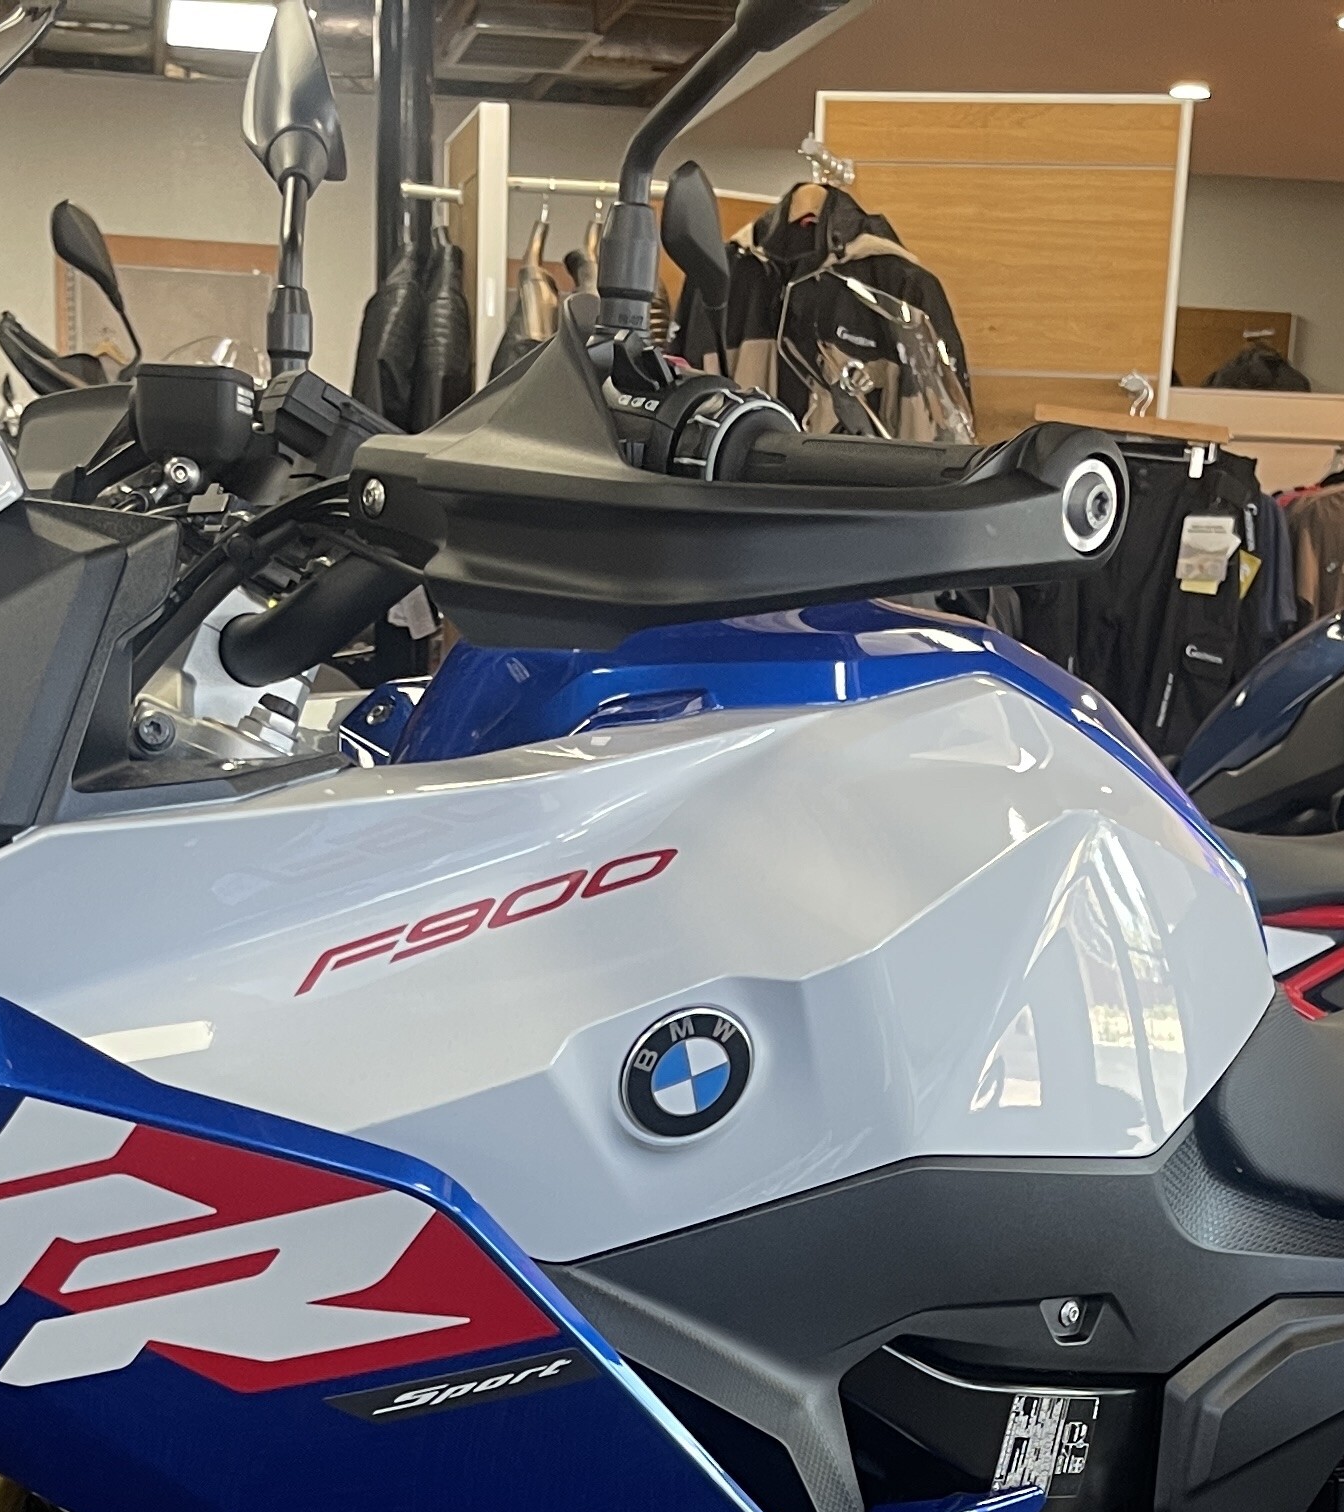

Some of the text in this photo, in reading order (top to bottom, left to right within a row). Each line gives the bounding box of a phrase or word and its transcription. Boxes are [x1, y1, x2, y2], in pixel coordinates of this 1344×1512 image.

[294, 848, 678, 996] F900
[633, 1016, 739, 1073] BMW
[373, 1357, 574, 1416] Sport
